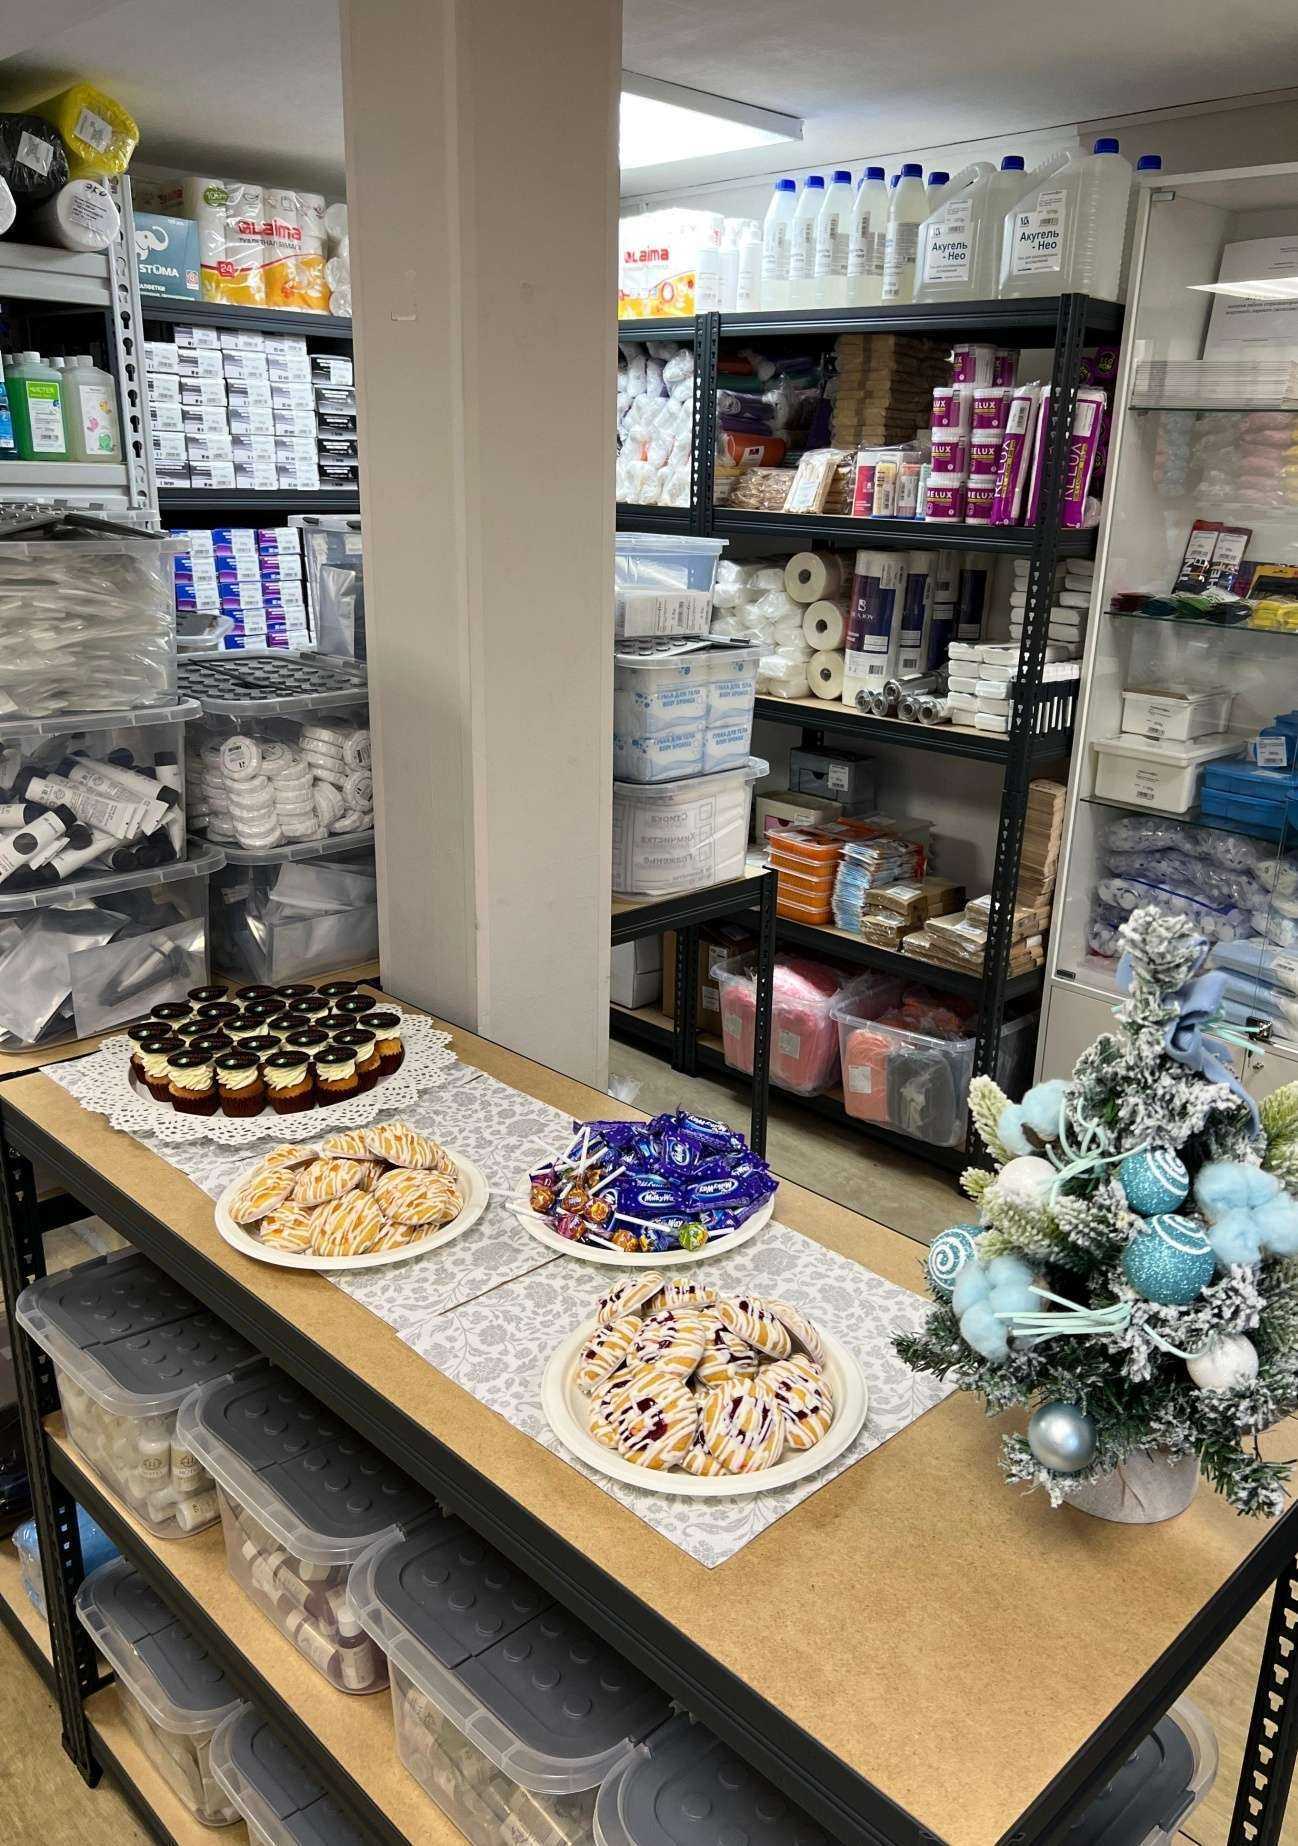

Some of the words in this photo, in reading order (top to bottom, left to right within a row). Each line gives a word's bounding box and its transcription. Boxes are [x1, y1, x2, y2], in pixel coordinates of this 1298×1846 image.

[1019, 229, 1060, 243] Акугель
[931, 241, 968, 253] Акугель
[1038, 240, 1057, 251] Нео
[632, 245, 670, 263] Laima
[947, 251, 966, 261] Нео
[220, 264, 234, 274] 24
